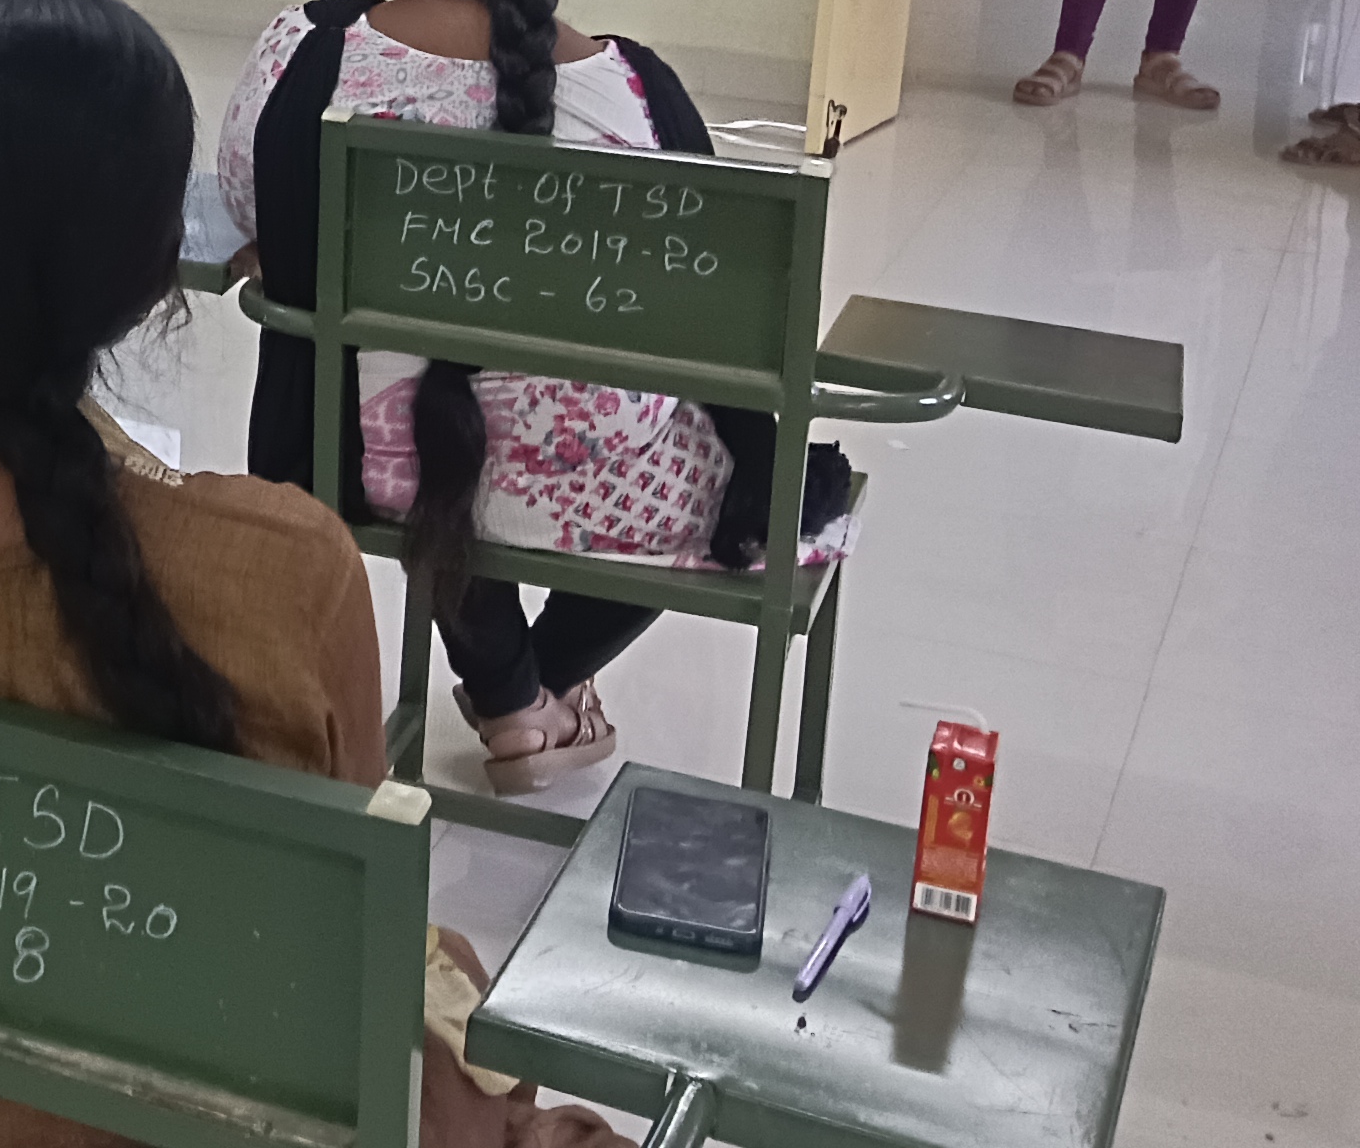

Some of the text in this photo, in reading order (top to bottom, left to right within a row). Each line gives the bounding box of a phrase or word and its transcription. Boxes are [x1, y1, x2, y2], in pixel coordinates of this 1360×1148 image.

[600, 183, 704, 219] TSD
[400, 210, 494, 246] FMC
[399, 256, 512, 303] SASC
[586, 276, 644, 313] 62
[11, 924, 52, 984] 8
